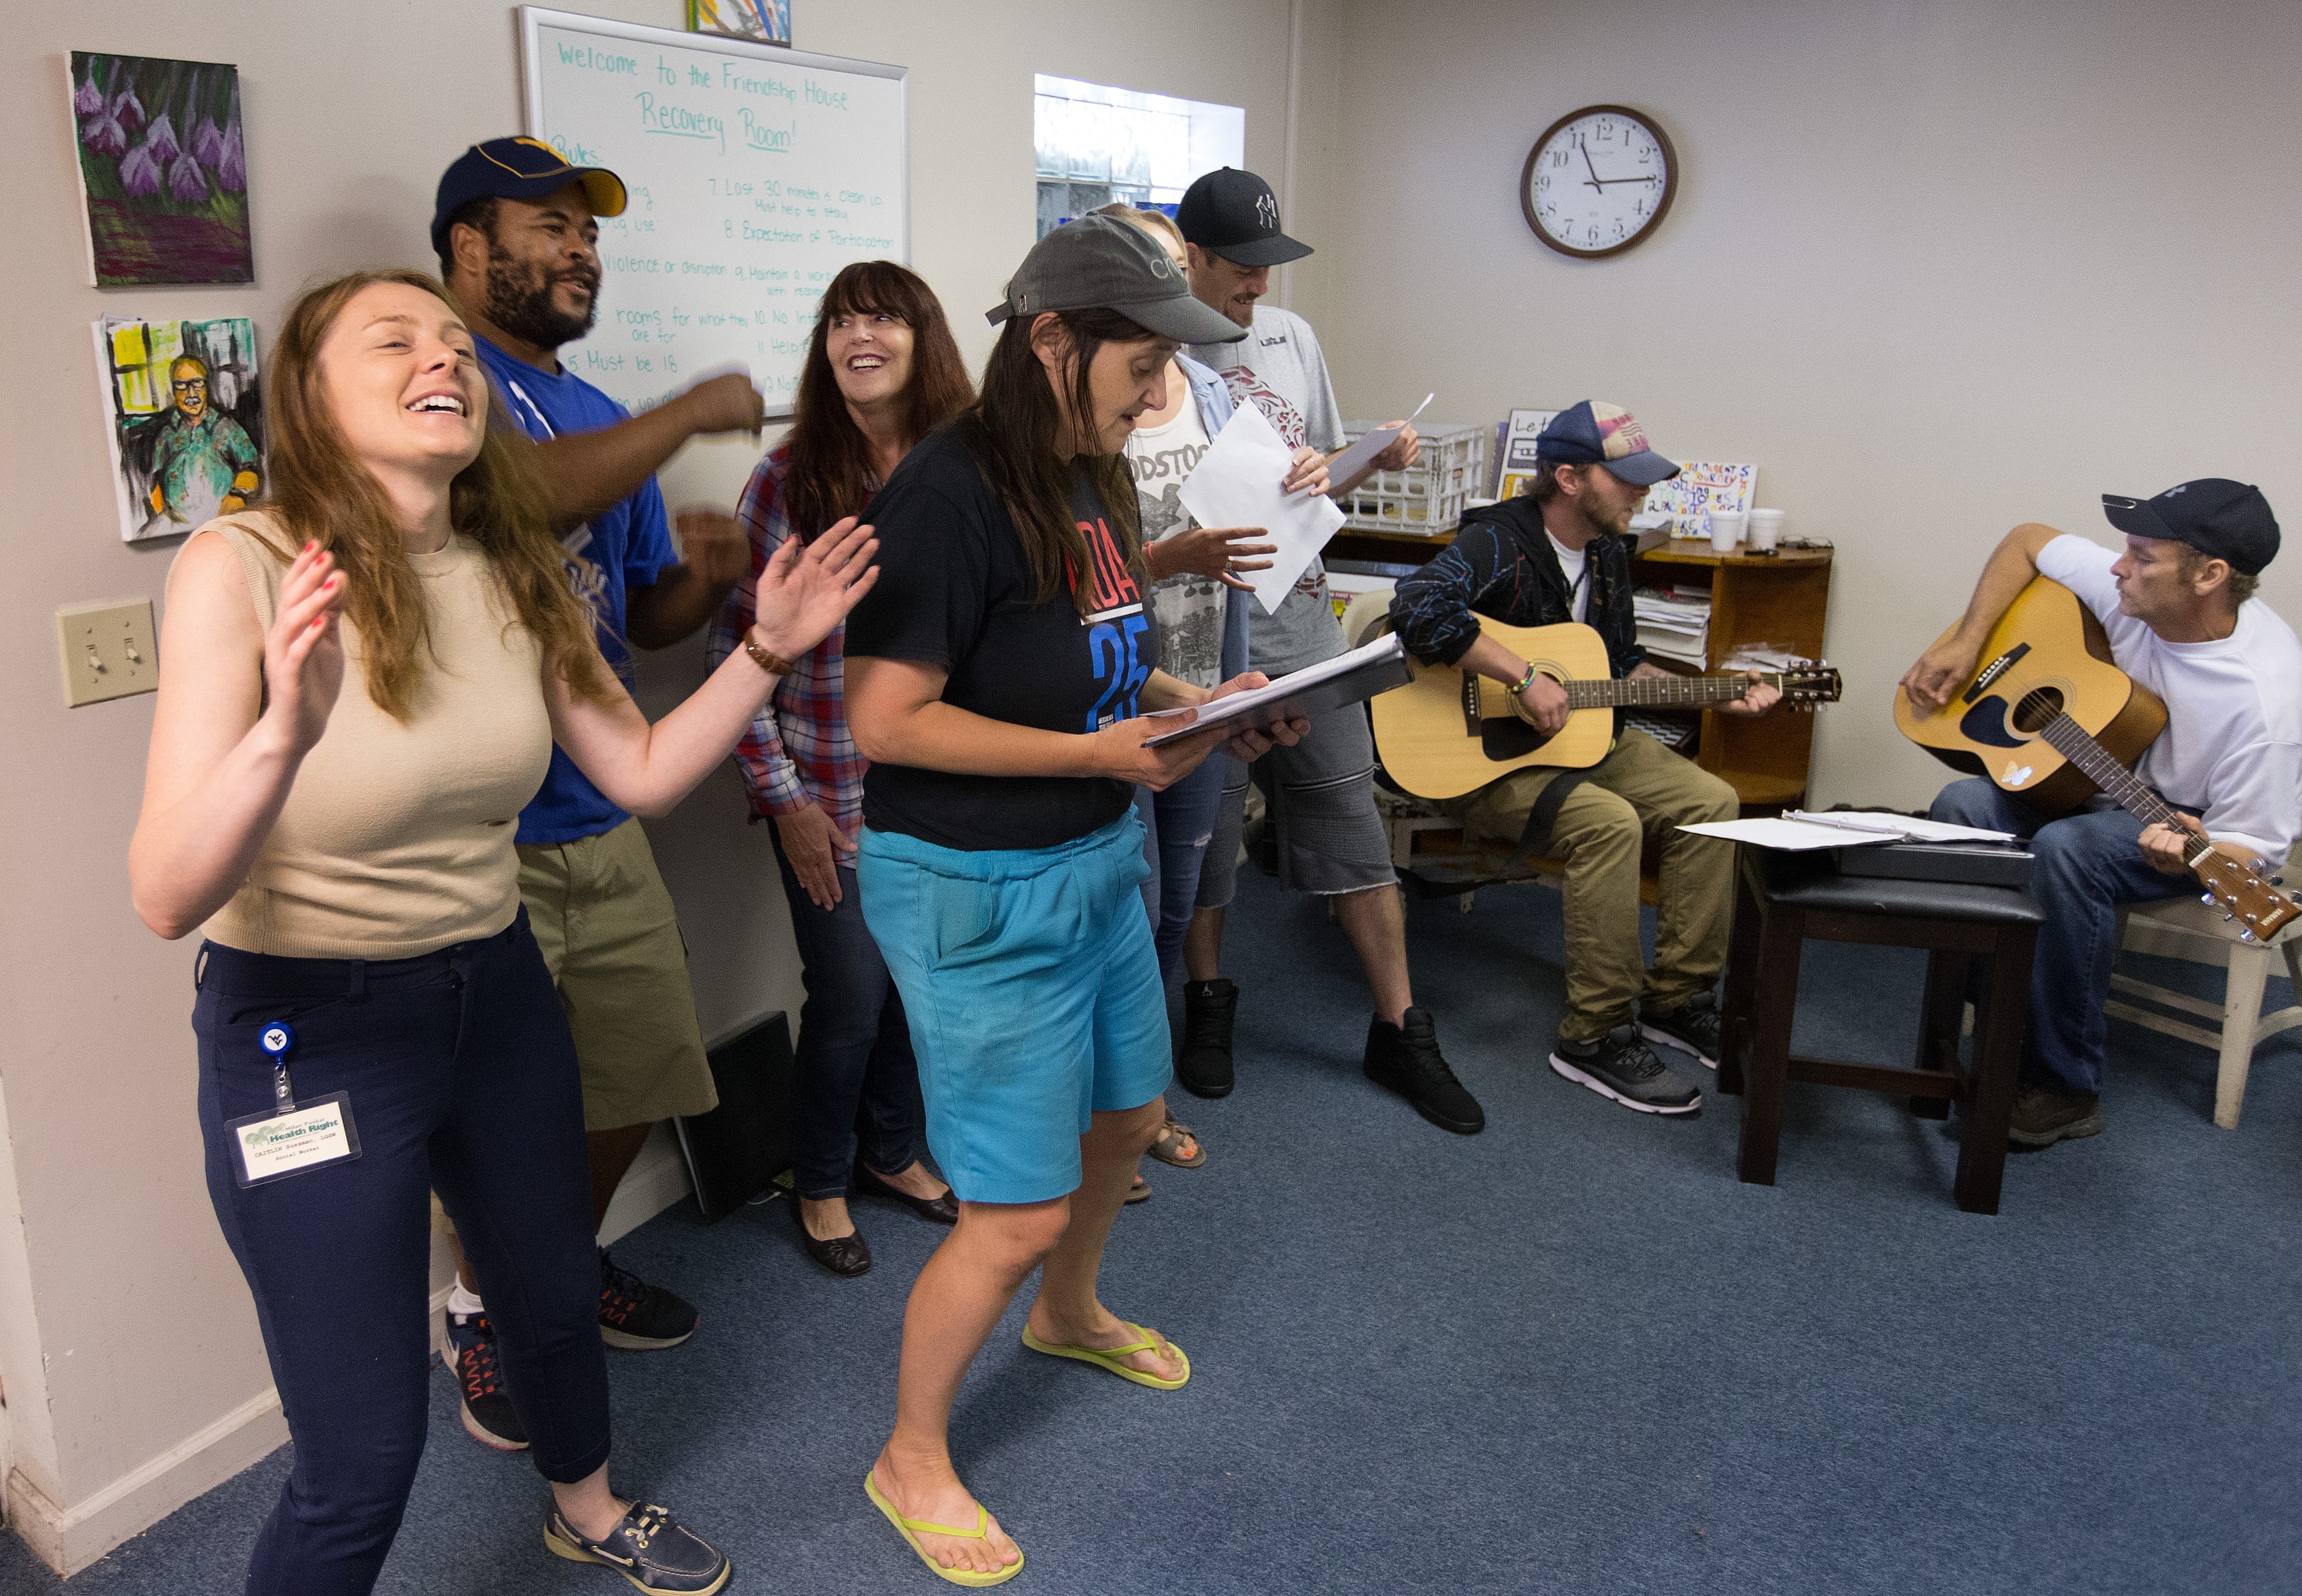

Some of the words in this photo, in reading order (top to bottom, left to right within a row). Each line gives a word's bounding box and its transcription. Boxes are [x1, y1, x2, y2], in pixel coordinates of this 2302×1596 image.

[558, 41, 638, 76] Welcome
[657, 54, 677, 86] to
[688, 64, 711, 88] the
[723, 62, 797, 105] Friendship
[804, 77, 848, 110] House
[635, 91, 726, 157] Recovery
[737, 107, 796, 149] Room!
[1596, 124, 1613, 140] 12
[551, 134, 604, 165] Rules:
[1638, 147, 1651, 163] 2
[1552, 150, 1568, 168] 10
[725, 178, 754, 196] Last
[763, 180, 783, 197] 30
[1539, 176, 1550, 192] 9
[755, 199, 777, 213] Must
[781, 200, 802, 218] help
[806, 206, 817, 217] to
[1546, 201, 1556, 219] 8
[1633, 198, 1644, 216] 4
[635, 219, 657, 232] use
[742, 219, 805, 244] Expectation
[810, 229, 822, 243] of
[827, 229, 894, 250] Participation
[1565, 218, 1575, 236] 7
[1588, 224, 1598, 241] 6
[1612, 218, 1624, 234] 5
[603, 253, 660, 273] Violence
[665, 261, 677, 274] or
[748, 265, 789, 281] Maintain
[616, 308, 661, 328] rooms
[672, 306, 691, 325] for
[698, 313, 726, 327] what
[773, 309, 788, 324] No
[632, 328, 649, 343] are
[658, 328, 676, 344] for
[770, 338, 799, 354] Help
[587, 349, 625, 371] Must
[636, 355, 653, 372] be
[663, 354, 678, 373] 18
[1084, 615, 1149, 733] 25
[269, 1127, 307, 1143] Health
[308, 1120, 339, 1133] Right
[254, 1146, 283, 1159] CAITLIN
